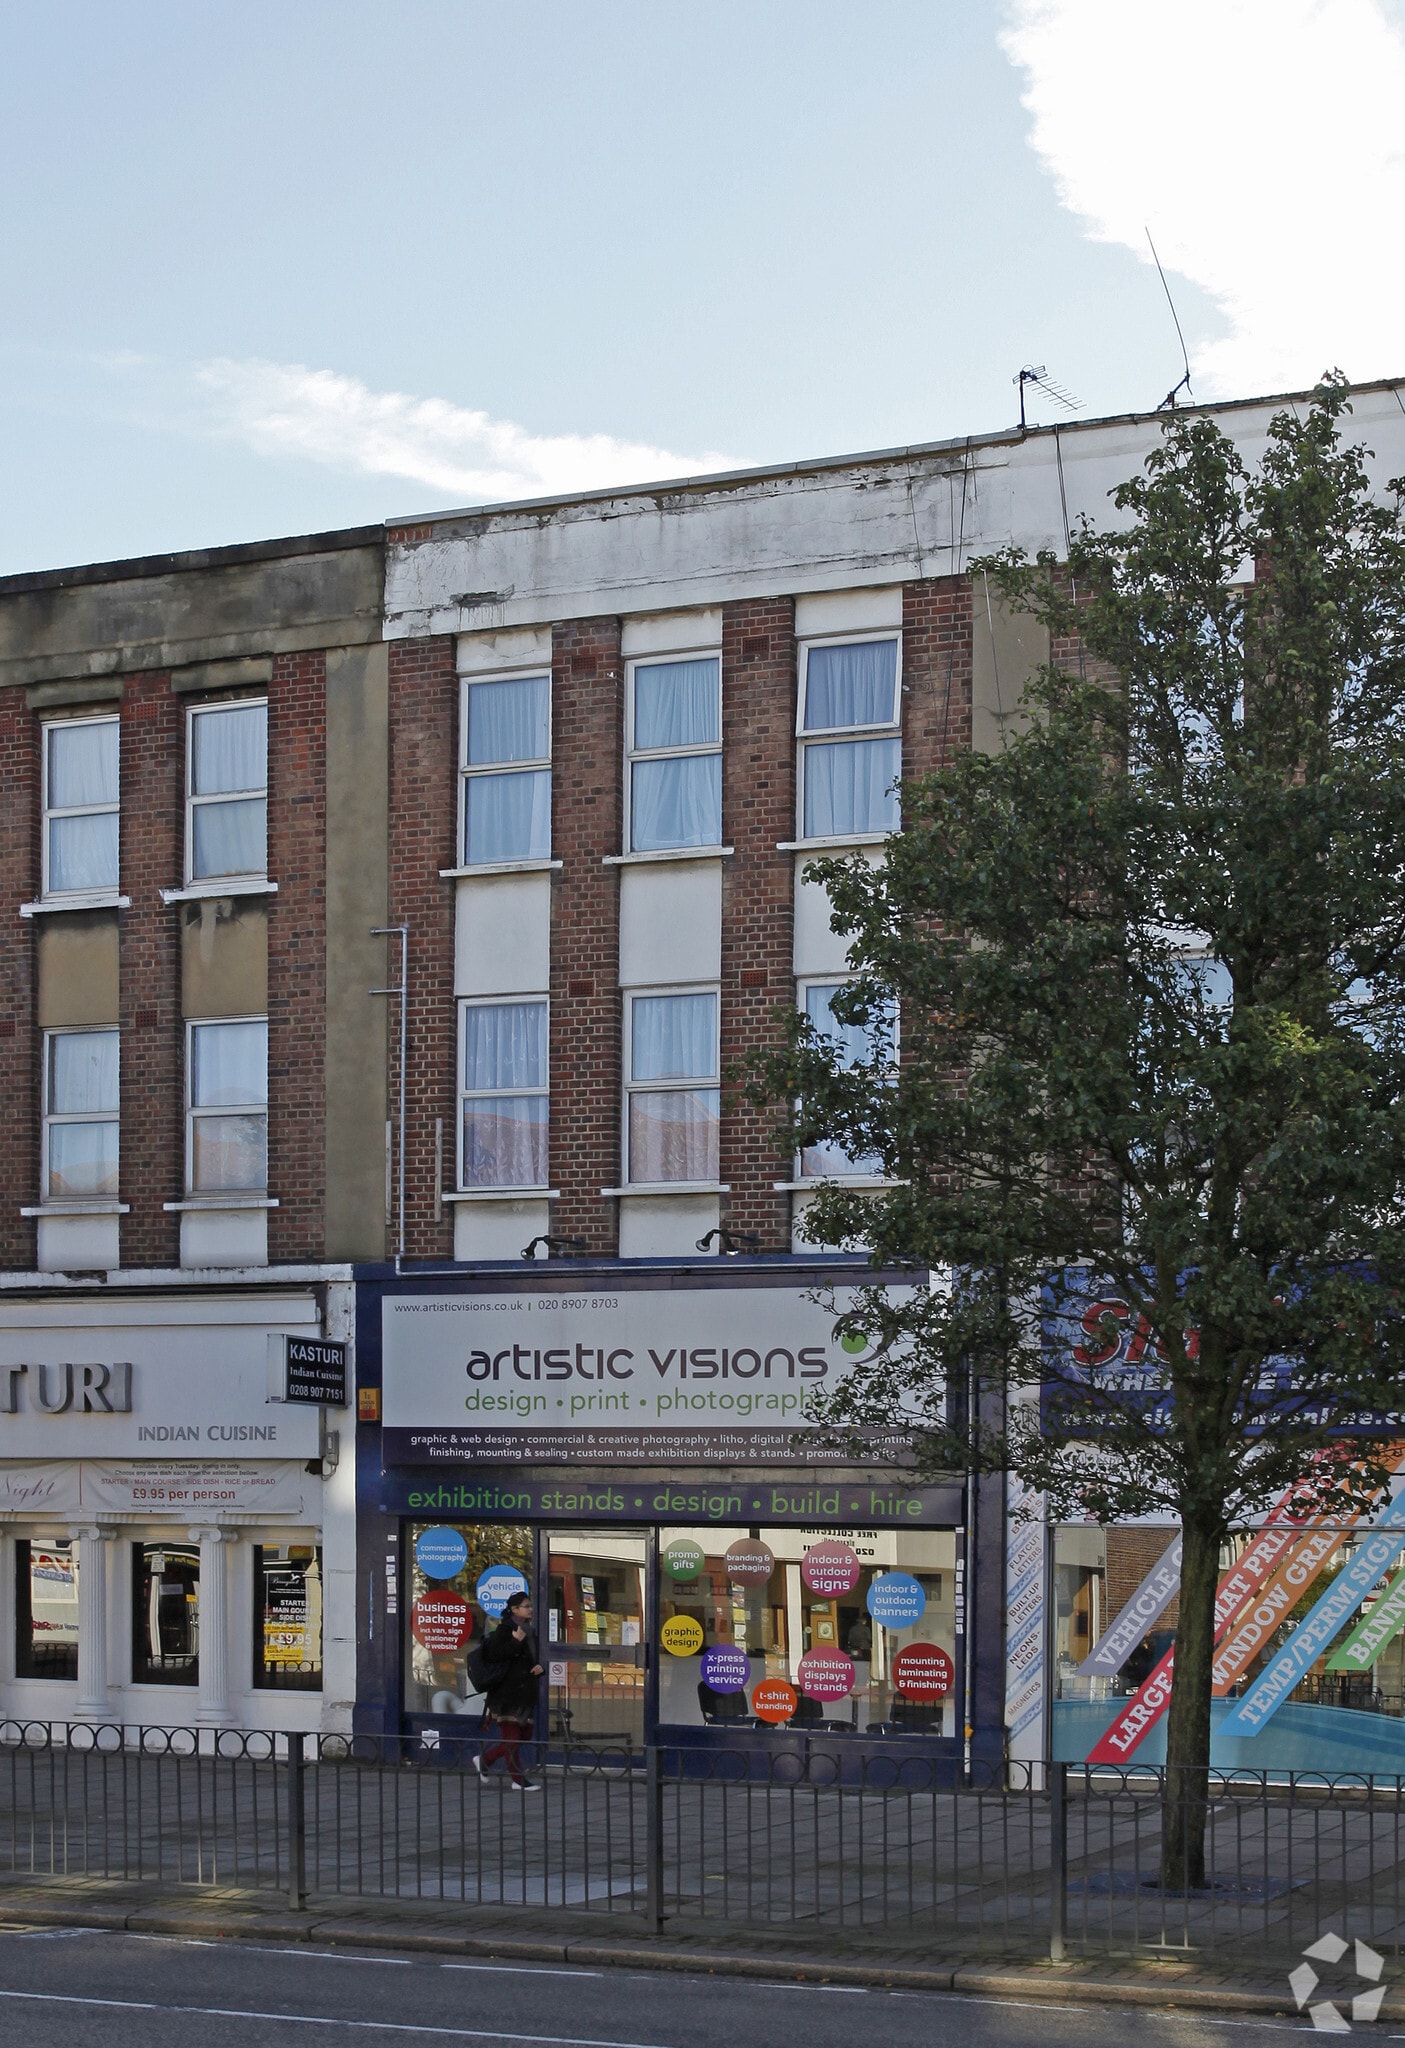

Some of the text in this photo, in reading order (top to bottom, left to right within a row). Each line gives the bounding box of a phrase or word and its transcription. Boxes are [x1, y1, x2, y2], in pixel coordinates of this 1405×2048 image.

[394, 1298, 619, 1312] www.artisticvisions.co.uk 020 8907 8703
[290, 1343, 343, 1365] KASTURI
[466, 1343, 829, 1381] artistic visions
[290, 1366, 343, 1381] Indian Cuisine
[290, 1384, 343, 1399] 0208 907 7151
[465, 1388, 547, 1417] design
[571, 1389, 630, 1417] print
[138, 1425, 277, 1441] INDIAN CUISINE
[410, 1434, 447, 1446] graphic
[450, 1435, 458, 1443] &
[460, 1434, 482, 1443] web
[485, 1434, 518, 1446] design
[527, 1434, 584, 1444] commercial
[587, 1435, 596, 1444] &
[599, 1434, 640, 1444] creative
[642, 1434, 710, 1446] photography
[720, 1434, 747, 1445] litho,
[750, 1434, 784, 1446] digital
[429, 1447, 474, 1459] finishing,
[477, 1448, 522, 1459] mounting
[524, 1448, 533, 1457] &
[534, 1448, 568, 1460] sealing
[577, 1448, 614, 1458] custom
[617, 1448, 645, 1458] made
[648, 1447, 700, 1458] exhibition
[703, 1448, 746, 1460] displays
[749, 1449, 757, 1458] &
[760, 1448, 796, 1458] stands
[101, 1478, 129, 1486] STARTER
[134, 1478, 151, 1486] MAIN
[153, 1478, 181, 1486] COURSE
[186, 1478, 202, 1486] SIDE
[204, 1478, 220, 1486] DISH
[225, 1478, 241, 1486] RICE
[251, 1478, 276, 1486] BREAD
[133, 1488, 236, 1501] £9.95 per person
[408, 1485, 923, 1519] exhibition stands design build hire
[668, 1551, 700, 1560] promo
[1009, 1534, 1041, 1569] FLATCUT
[417, 1554, 466, 1562] photography
[726, 1554, 763, 1563] branding
[808, 1555, 853, 1564] indoor &
[1015, 1546, 1042, 1577] LETTERS
[673, 1560, 695, 1570] gifts
[727, 1564, 771, 1573] packaging
[809, 1567, 852, 1576] outdoor
[487, 1582, 521, 1591] vehicle
[812, 1577, 850, 1592] signs
[874, 1584, 918, 1594] indoor &
[875, 1596, 917, 1605] outdoor
[1008, 1582, 1040, 1618] BUILT-UP
[417, 1602, 467, 1613] business
[873, 1606, 919, 1617] banners
[1014, 1594, 1042, 1625] LETTERS
[417, 1614, 466, 1626] package
[1095, 1568, 1178, 1666] VEHICLE
[448, 1627, 463, 1636] sign
[665, 1628, 700, 1638] graphic
[1212, 1583, 1291, 1686] WINDOW
[424, 1635, 459, 1643] stationery
[666, 1638, 699, 1648] design
[431, 1643, 458, 1651] website
[1016, 1646, 1039, 1671] LEDS
[1238, 1581, 1358, 1726] TEMP/PERM
[707, 1655, 745, 1664] x-press
[801, 1659, 852, 1670] exhibition
[901, 1657, 946, 1667] mounting
[706, 1664, 746, 1675] printing
[898, 1668, 948, 1679] laminating
[708, 1675, 744, 1685] service
[804, 1670, 846, 1681] displays
[804, 1683, 848, 1692] & stands
[899, 1680, 947, 1691] & finishing
[759, 1691, 790, 1700] t-shirt
[1007, 1681, 1041, 1717] MAGNETICS
[756, 1701, 793, 1712] branding
[1108, 1671, 1173, 1752] LARGE
